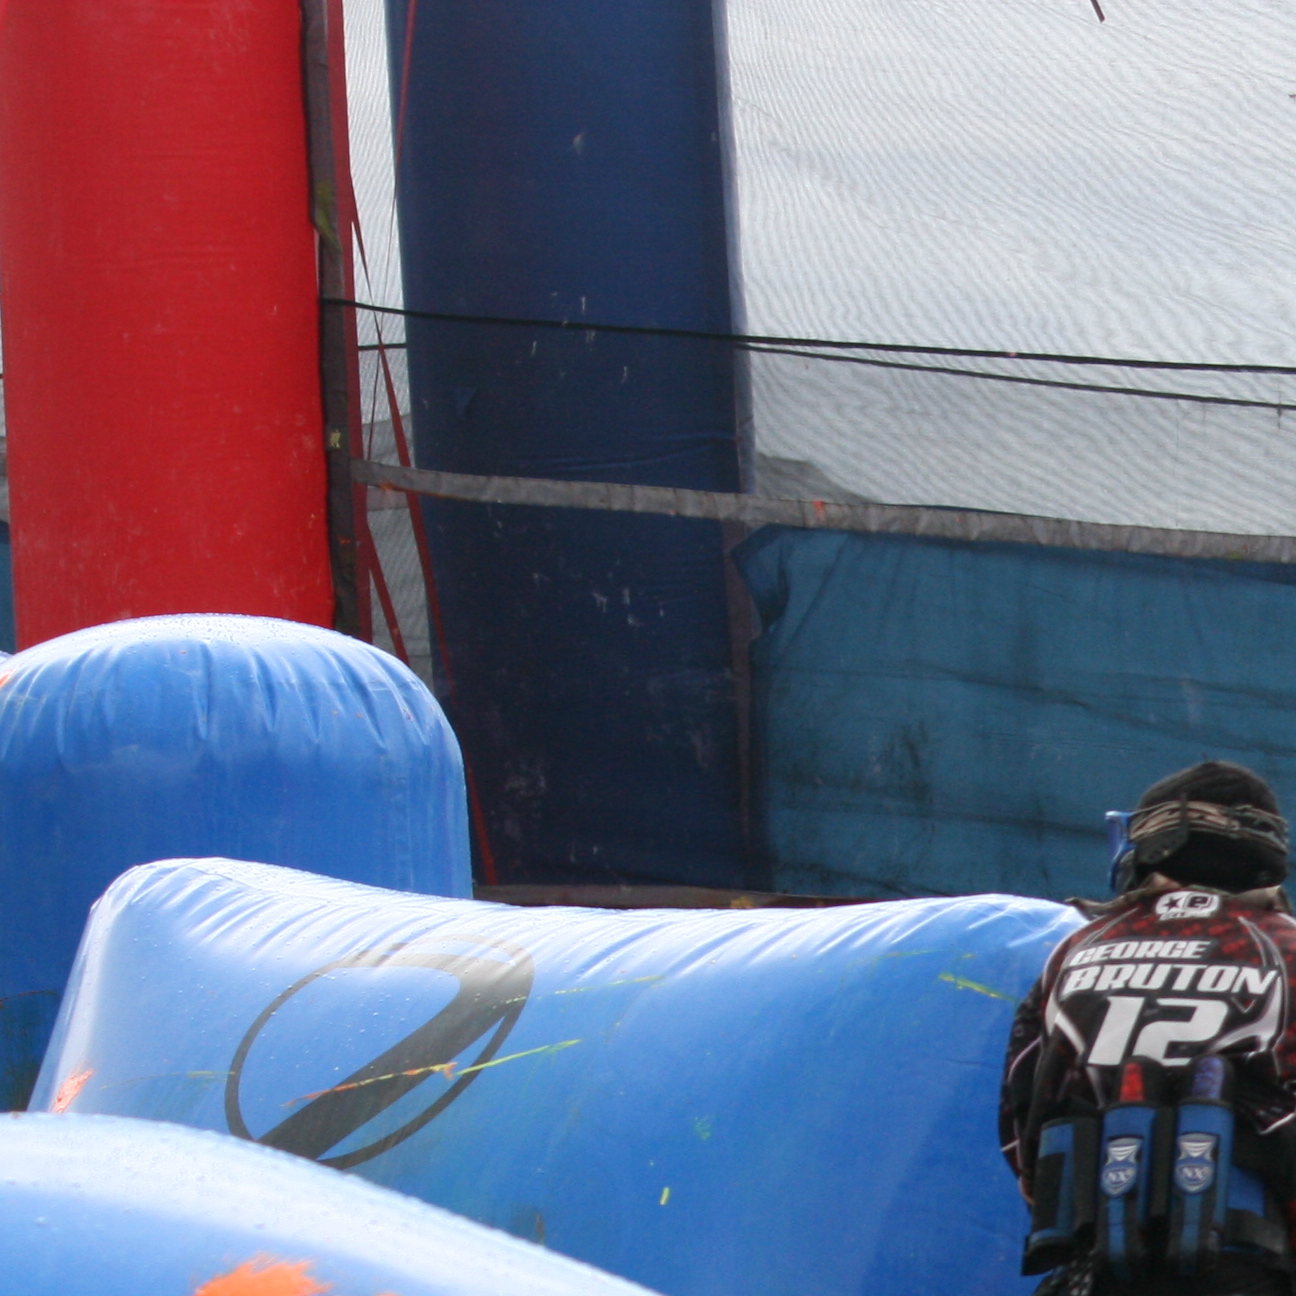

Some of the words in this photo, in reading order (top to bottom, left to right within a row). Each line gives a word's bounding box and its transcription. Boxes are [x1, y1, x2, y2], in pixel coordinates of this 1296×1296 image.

[1068, 940, 1211, 967] GEORGE
[1060, 963, 1279, 1000] BRUTON
[1087, 995, 1229, 1067] 12
